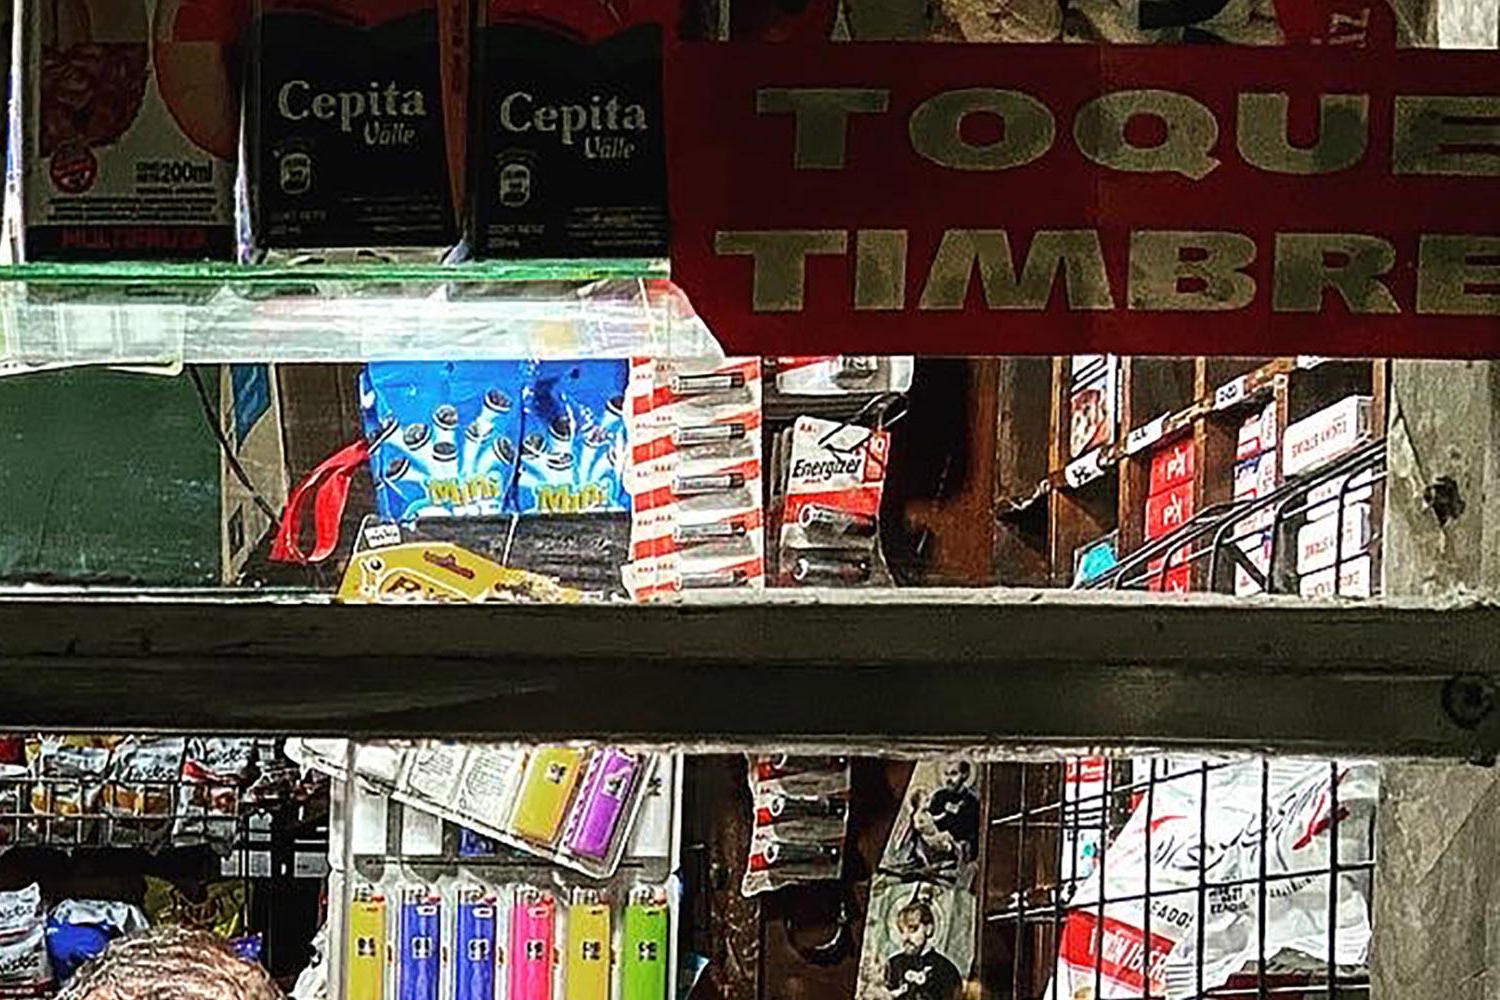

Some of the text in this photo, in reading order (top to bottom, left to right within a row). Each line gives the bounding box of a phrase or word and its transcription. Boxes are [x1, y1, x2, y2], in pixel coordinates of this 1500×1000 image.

[278, 80, 427, 132] Cepita
[500, 92, 648, 144] Cepita
[363, 121, 416, 146] Valle
[584, 136, 636, 159] Valle
[756, 88, 1500, 180] TOQUE
[714, 229, 1500, 315] TIMBRE
[792, 458, 862, 481] Energizer
